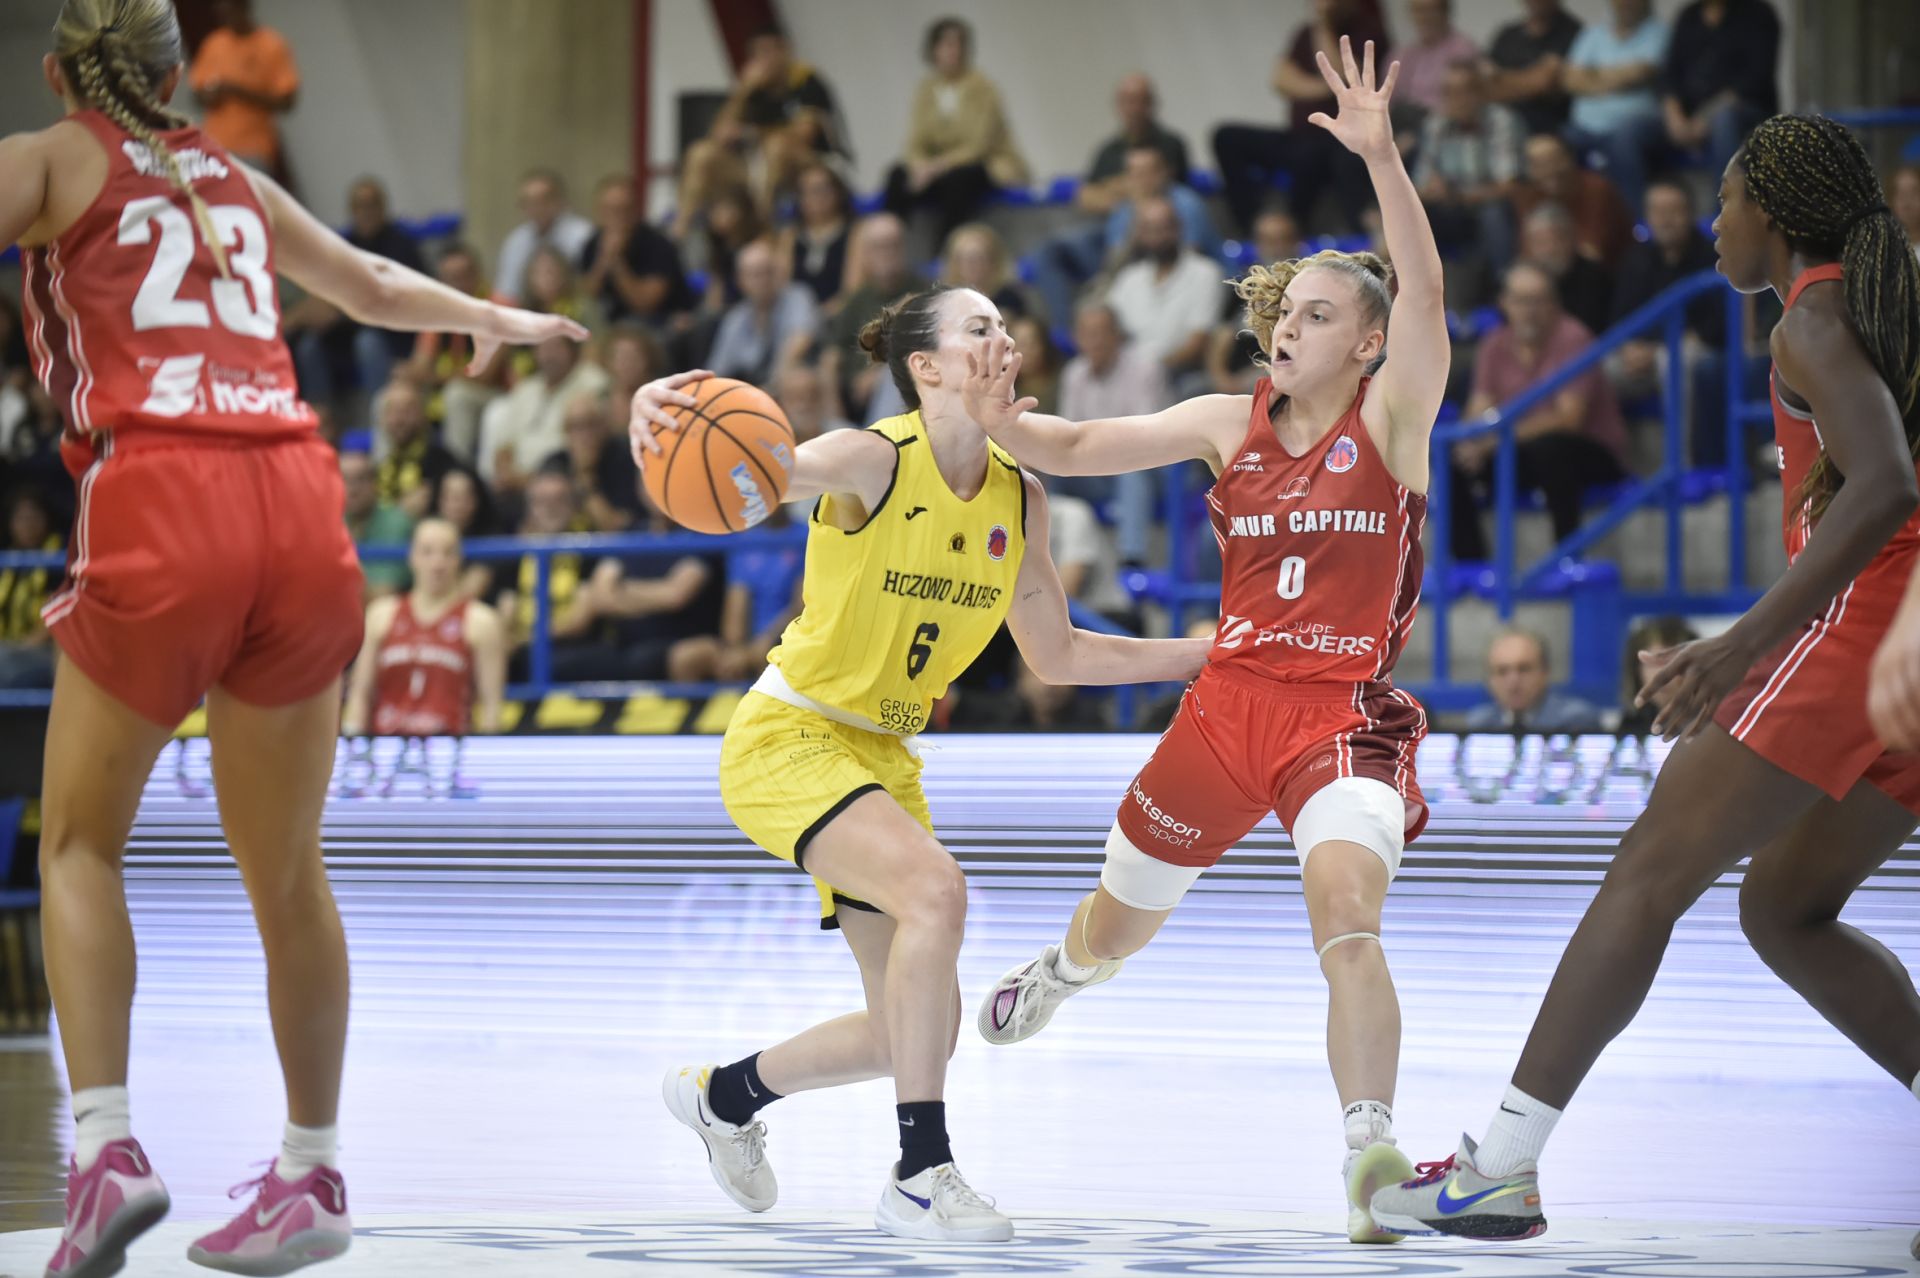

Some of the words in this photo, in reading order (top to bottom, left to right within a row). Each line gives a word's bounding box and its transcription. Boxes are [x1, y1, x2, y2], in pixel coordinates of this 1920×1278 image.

[117, 196, 278, 341] 23
[1233, 464, 1264, 473] DHIKA
[1288, 510, 1386, 535] CAPITALE
[1277, 555, 1306, 600] 0
[907, 622, 940, 681] 6
[880, 698, 924, 716] GRUP
[1133, 778, 1202, 840] betsson
